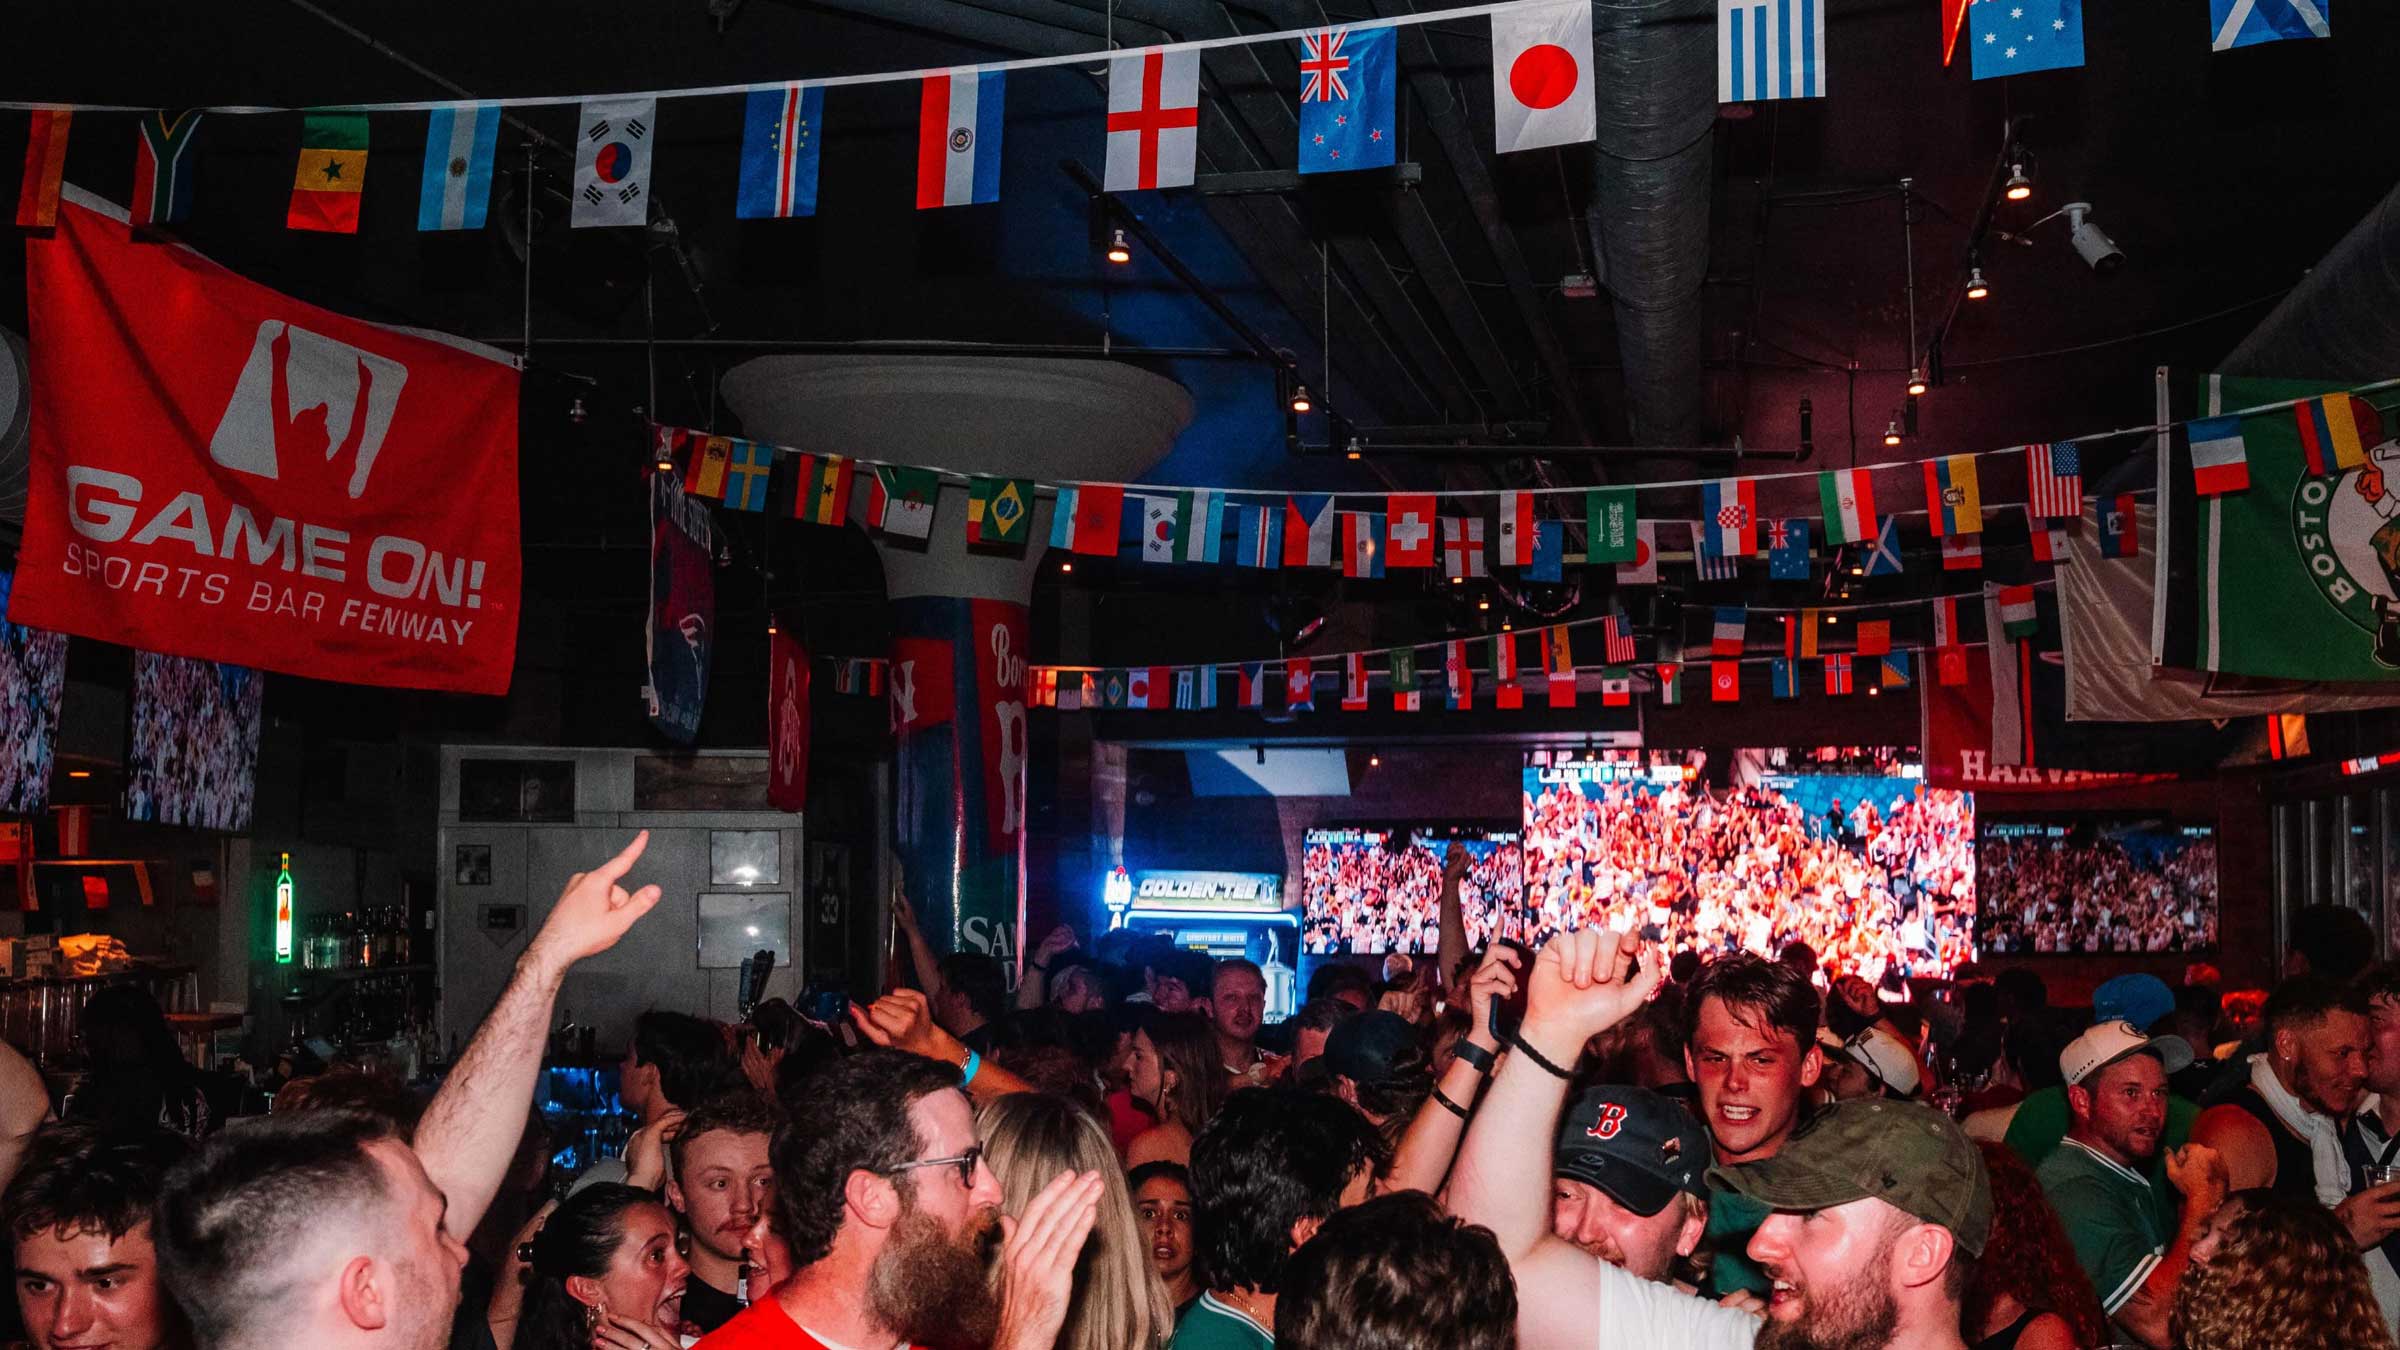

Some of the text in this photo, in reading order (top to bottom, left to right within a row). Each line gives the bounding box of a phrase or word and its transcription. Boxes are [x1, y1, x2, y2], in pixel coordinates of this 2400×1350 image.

[67, 465, 486, 609] GAME ON!
[2299, 476, 2357, 604] BOSTO
[63, 542, 474, 646] SPORTS BAR FENWAY
[1960, 749, 2119, 784] HARV
[1139, 878, 1258, 900] GOLDEN TEE
[1586, 1101, 1628, 1139] B
